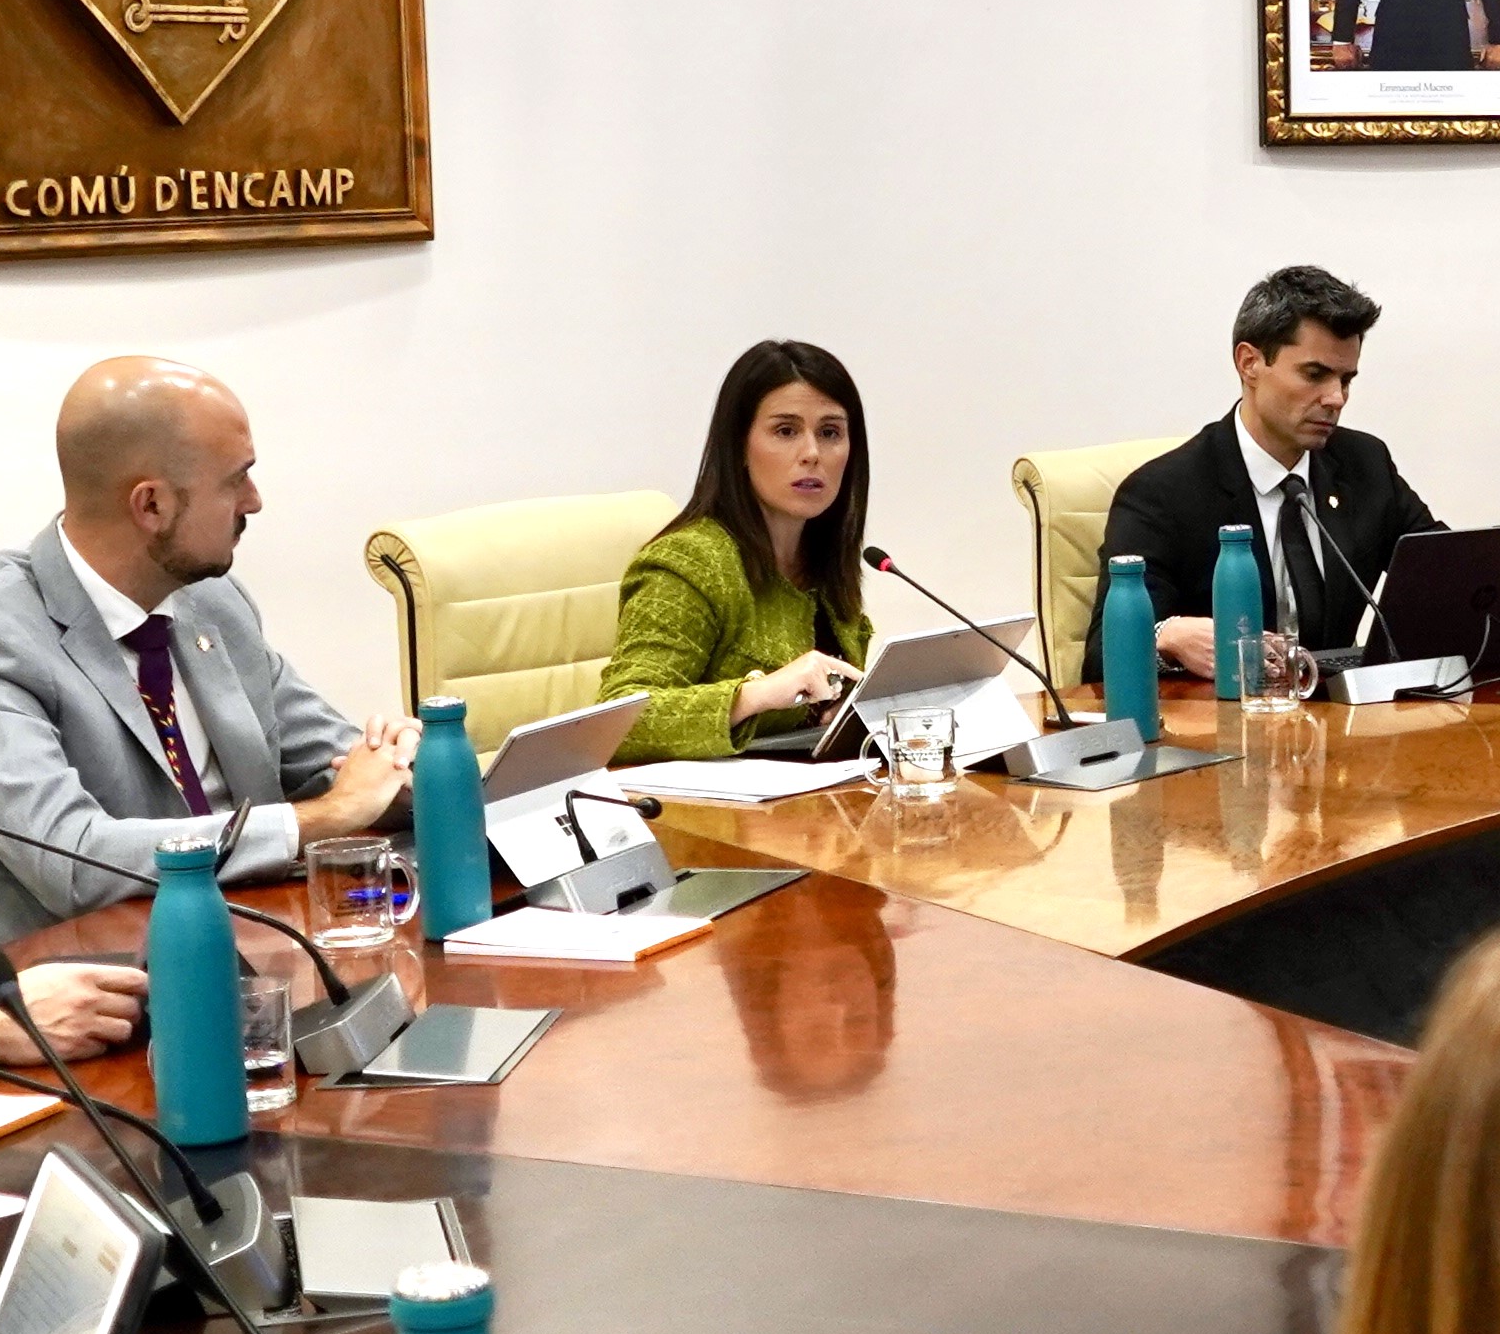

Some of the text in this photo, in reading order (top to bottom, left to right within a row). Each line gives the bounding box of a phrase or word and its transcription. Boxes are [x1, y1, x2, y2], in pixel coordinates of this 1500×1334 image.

[1379, 83, 1453, 92] Emmanuel Macron
[5, 165, 355, 217] COMÚ D'ENCAMP
